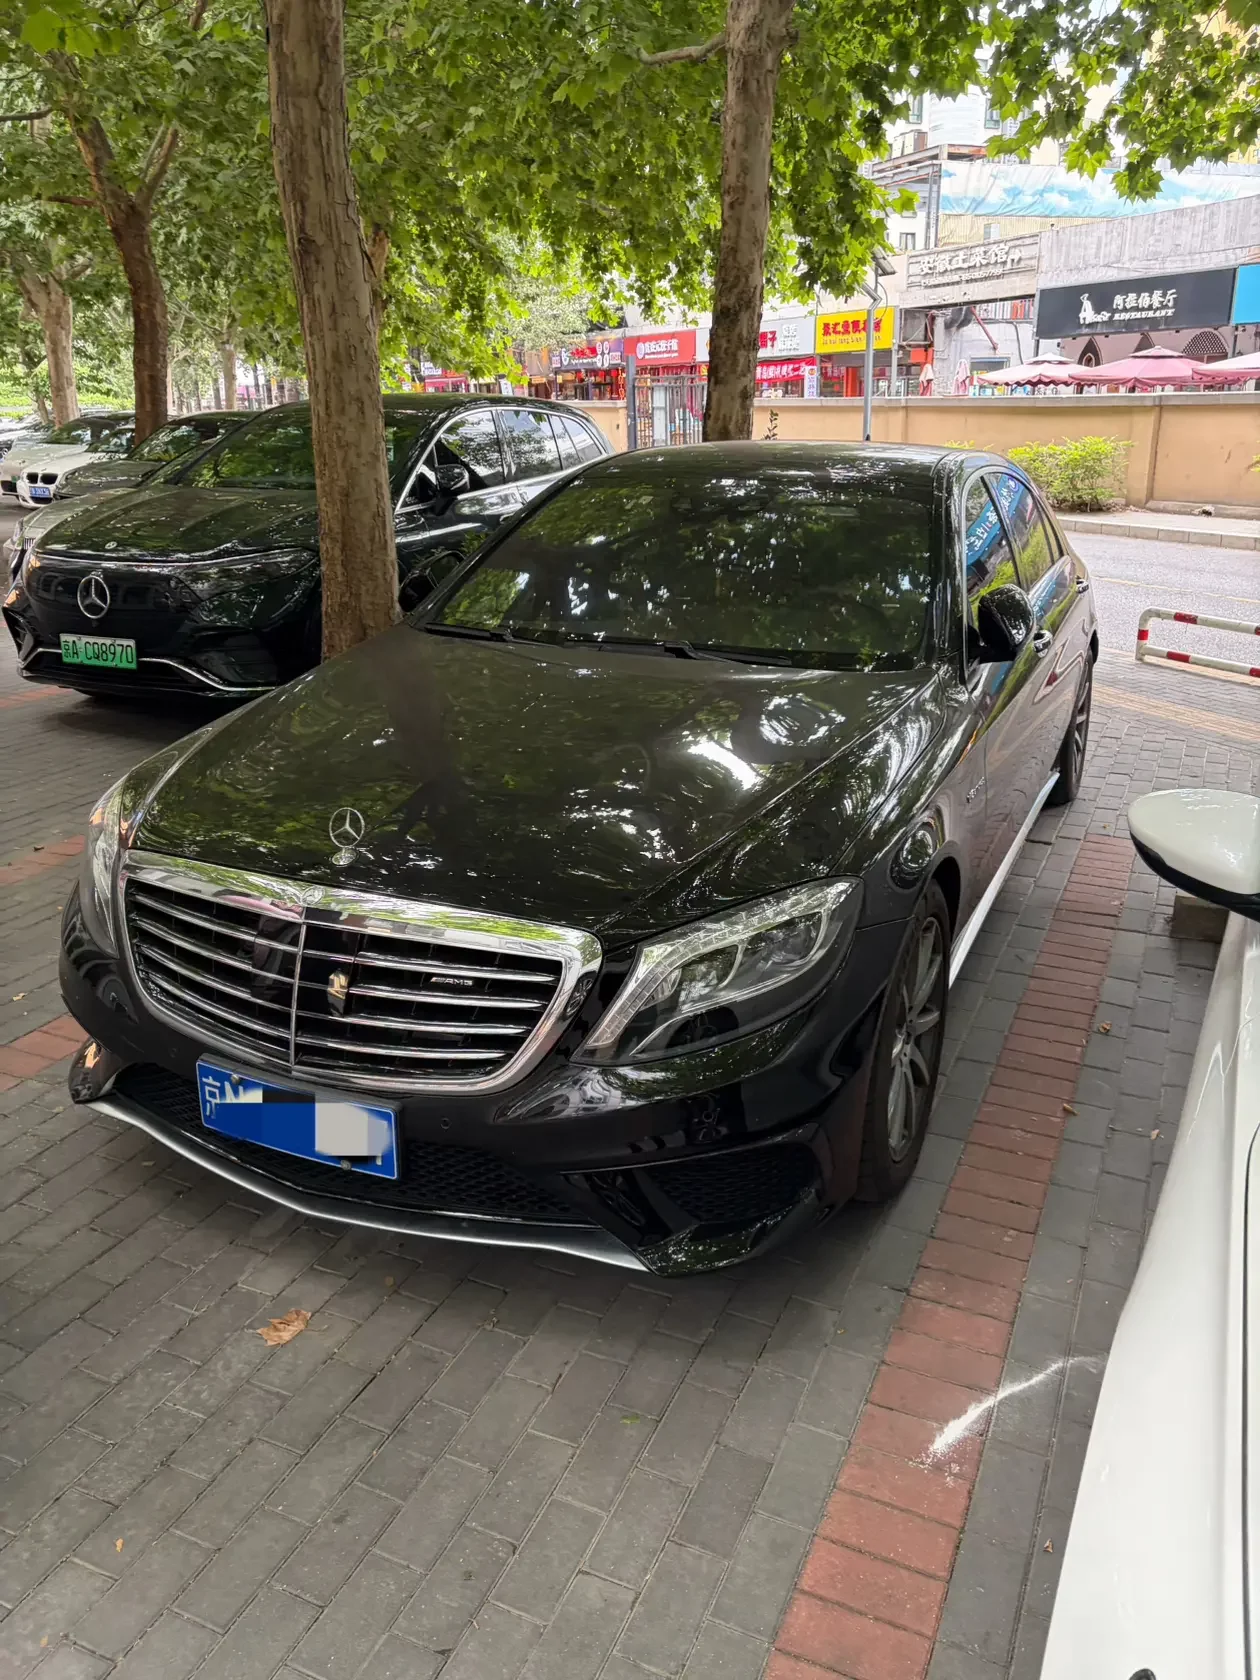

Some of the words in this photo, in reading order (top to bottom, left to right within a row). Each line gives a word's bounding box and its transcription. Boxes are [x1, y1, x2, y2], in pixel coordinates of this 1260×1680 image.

[918, 243, 1010, 275] 安徽土菜馆
[1113, 289, 1178, 310] 阿拉伯餐厅
[1112, 308, 1176, 321] RESTAURANT
[444, 977, 473, 986] AMG
